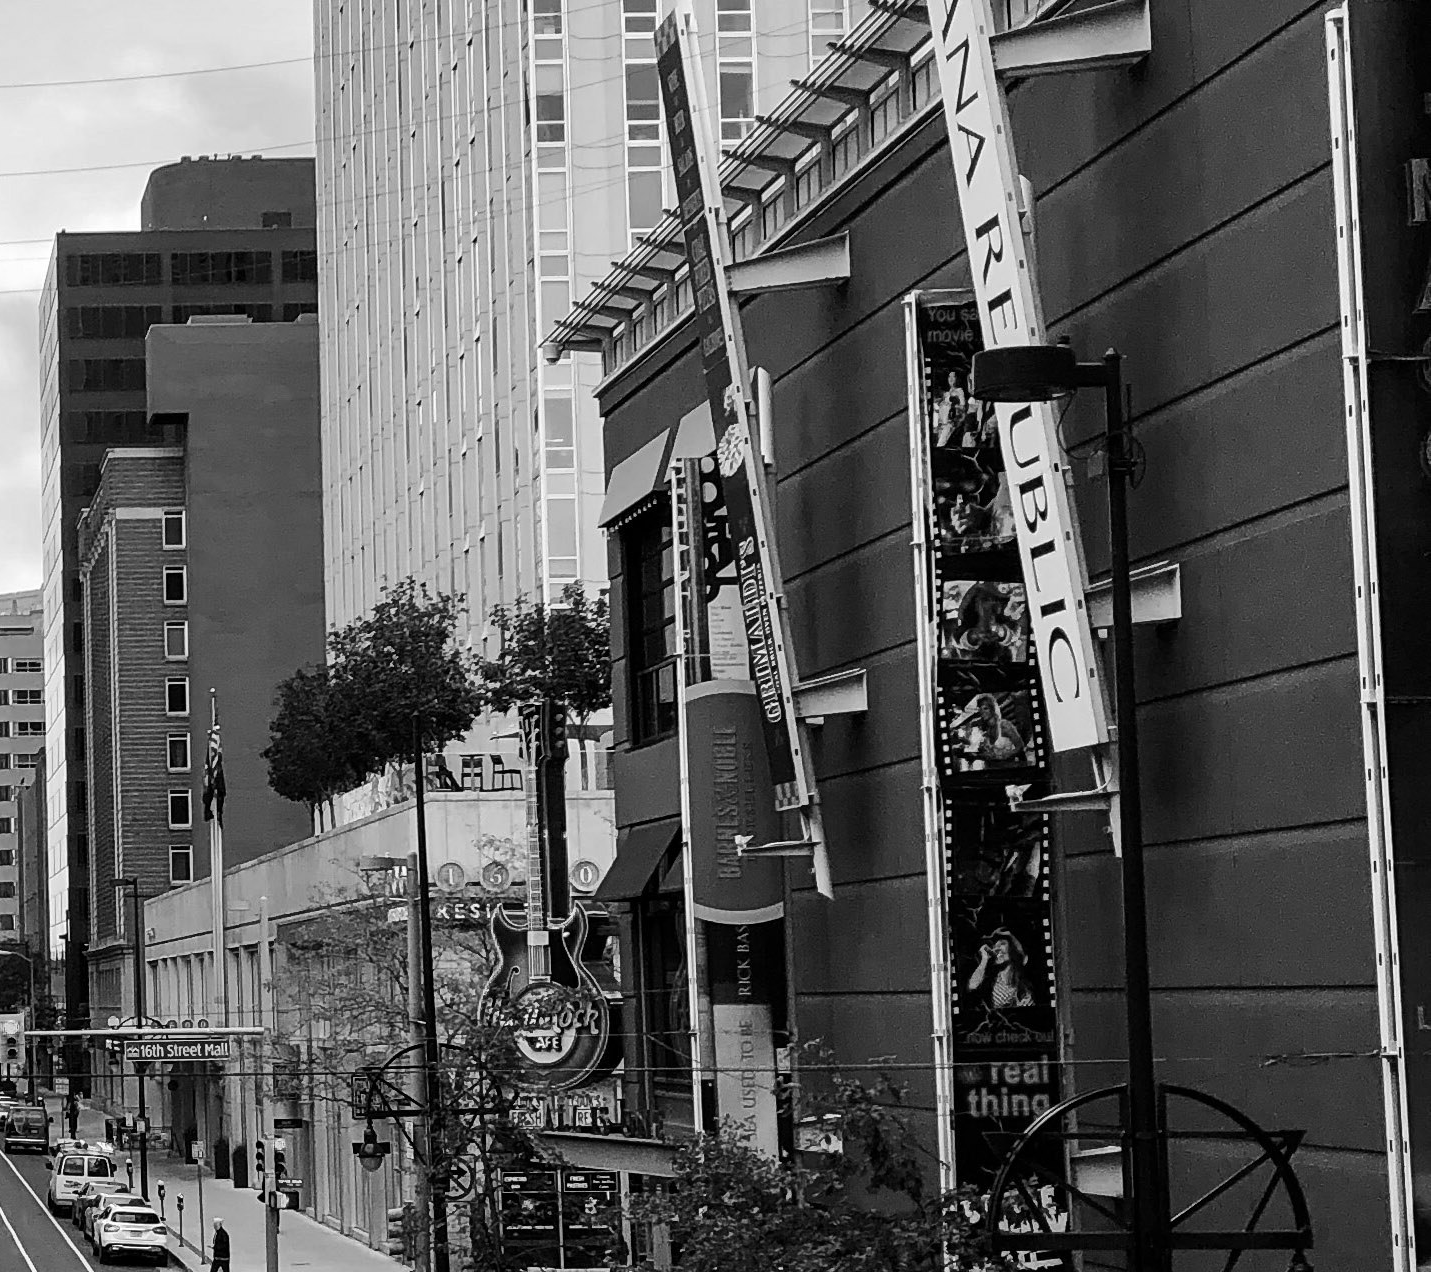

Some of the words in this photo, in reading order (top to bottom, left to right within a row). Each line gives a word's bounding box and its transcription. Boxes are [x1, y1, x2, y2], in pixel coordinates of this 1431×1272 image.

[928, 308, 956, 322] You
[975, 215, 1082, 706] REUBLIC
[738, 536, 782, 723] GRIMALDI'S
[736, 957, 752, 996] RICK
[140, 1043, 164, 1058] 16th
[167, 1042, 202, 1058] Street
[205, 1041, 229, 1057] Mall
[534, 1036, 560, 1049] AFE
[739, 1041, 753, 1062] TO
[990, 1053, 1050, 1083] real
[739, 1071, 756, 1109] USED
[969, 1087, 1050, 1117] thing
